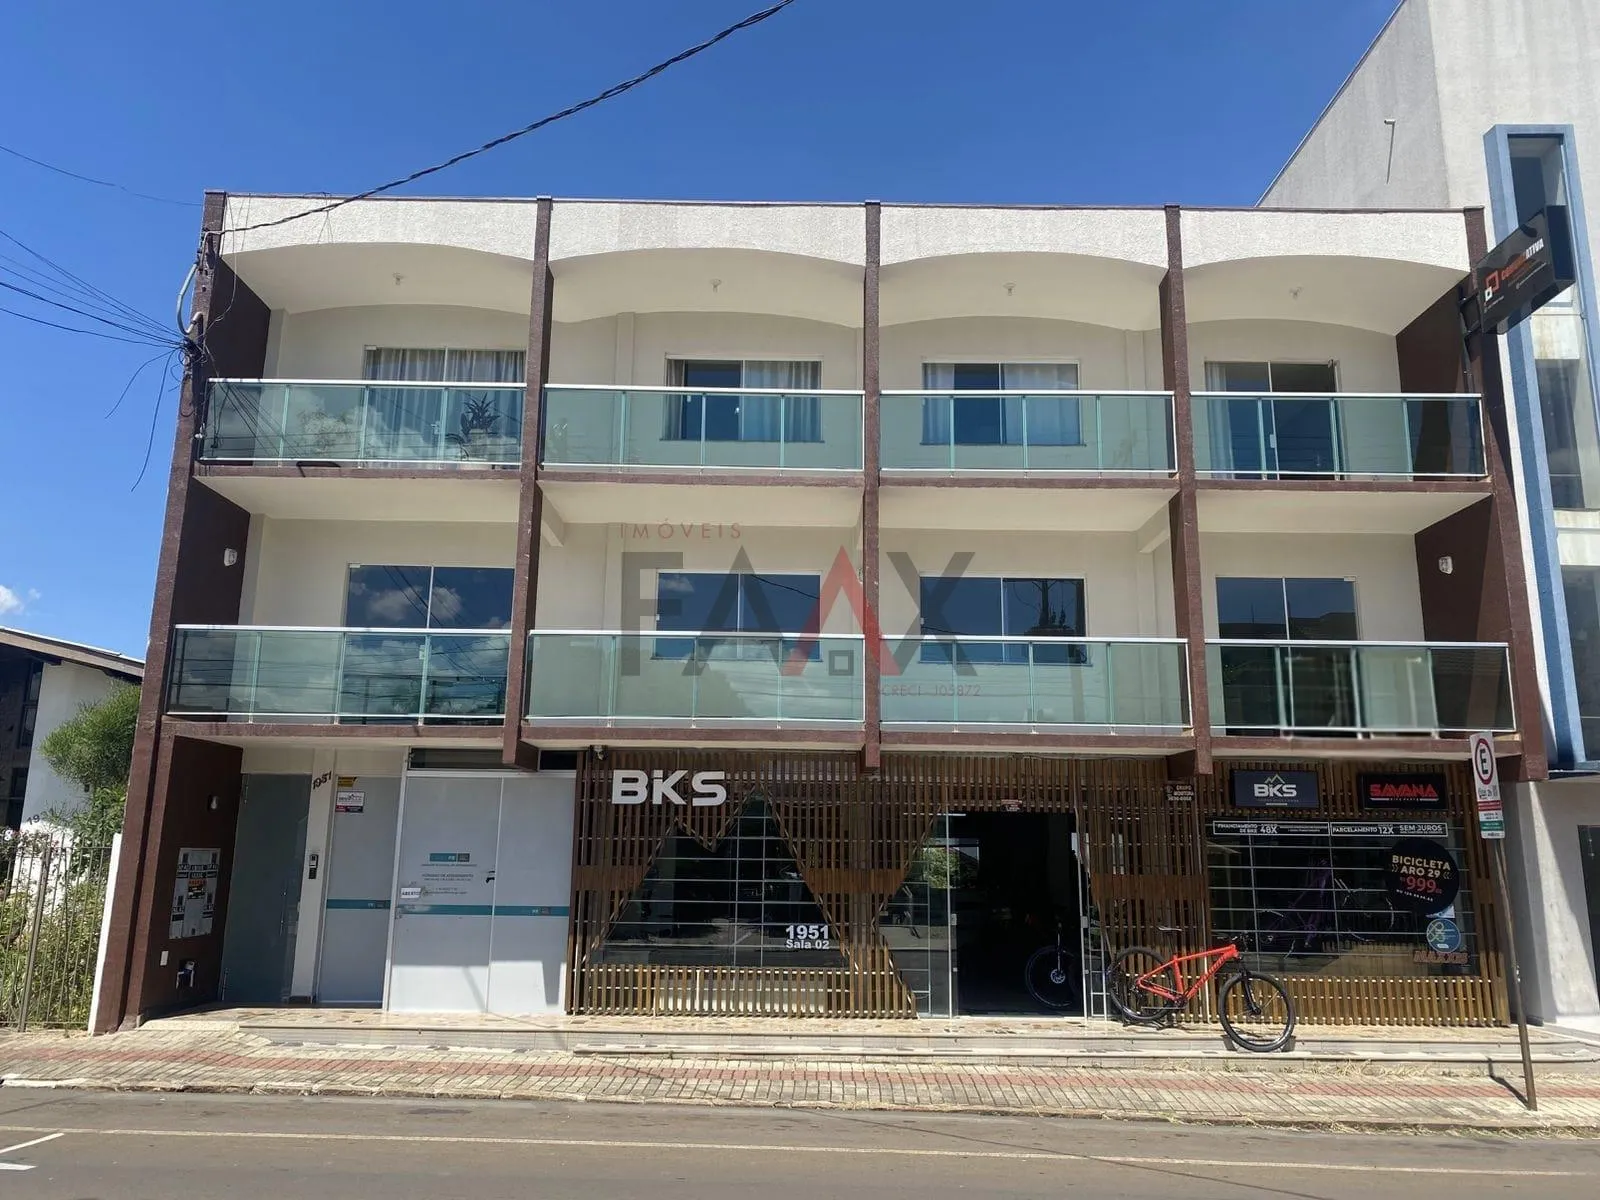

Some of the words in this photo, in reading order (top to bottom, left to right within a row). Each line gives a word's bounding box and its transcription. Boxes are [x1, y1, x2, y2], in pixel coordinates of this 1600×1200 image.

[1480, 748, 1489, 775] E
[313, 770, 332, 790] 1951
[611, 769, 727, 807] BKS
[1253, 783, 1298, 798] BKS
[1370, 783, 1438, 798] SAVANA
[1391, 855, 1451, 871] BICICLETA
[1400, 865, 1425, 876] ARO
[1427, 868, 1441, 879] 29
[785, 924, 829, 940] 1951
[785, 939, 812, 949] Sala
[815, 939, 830, 950] 02
